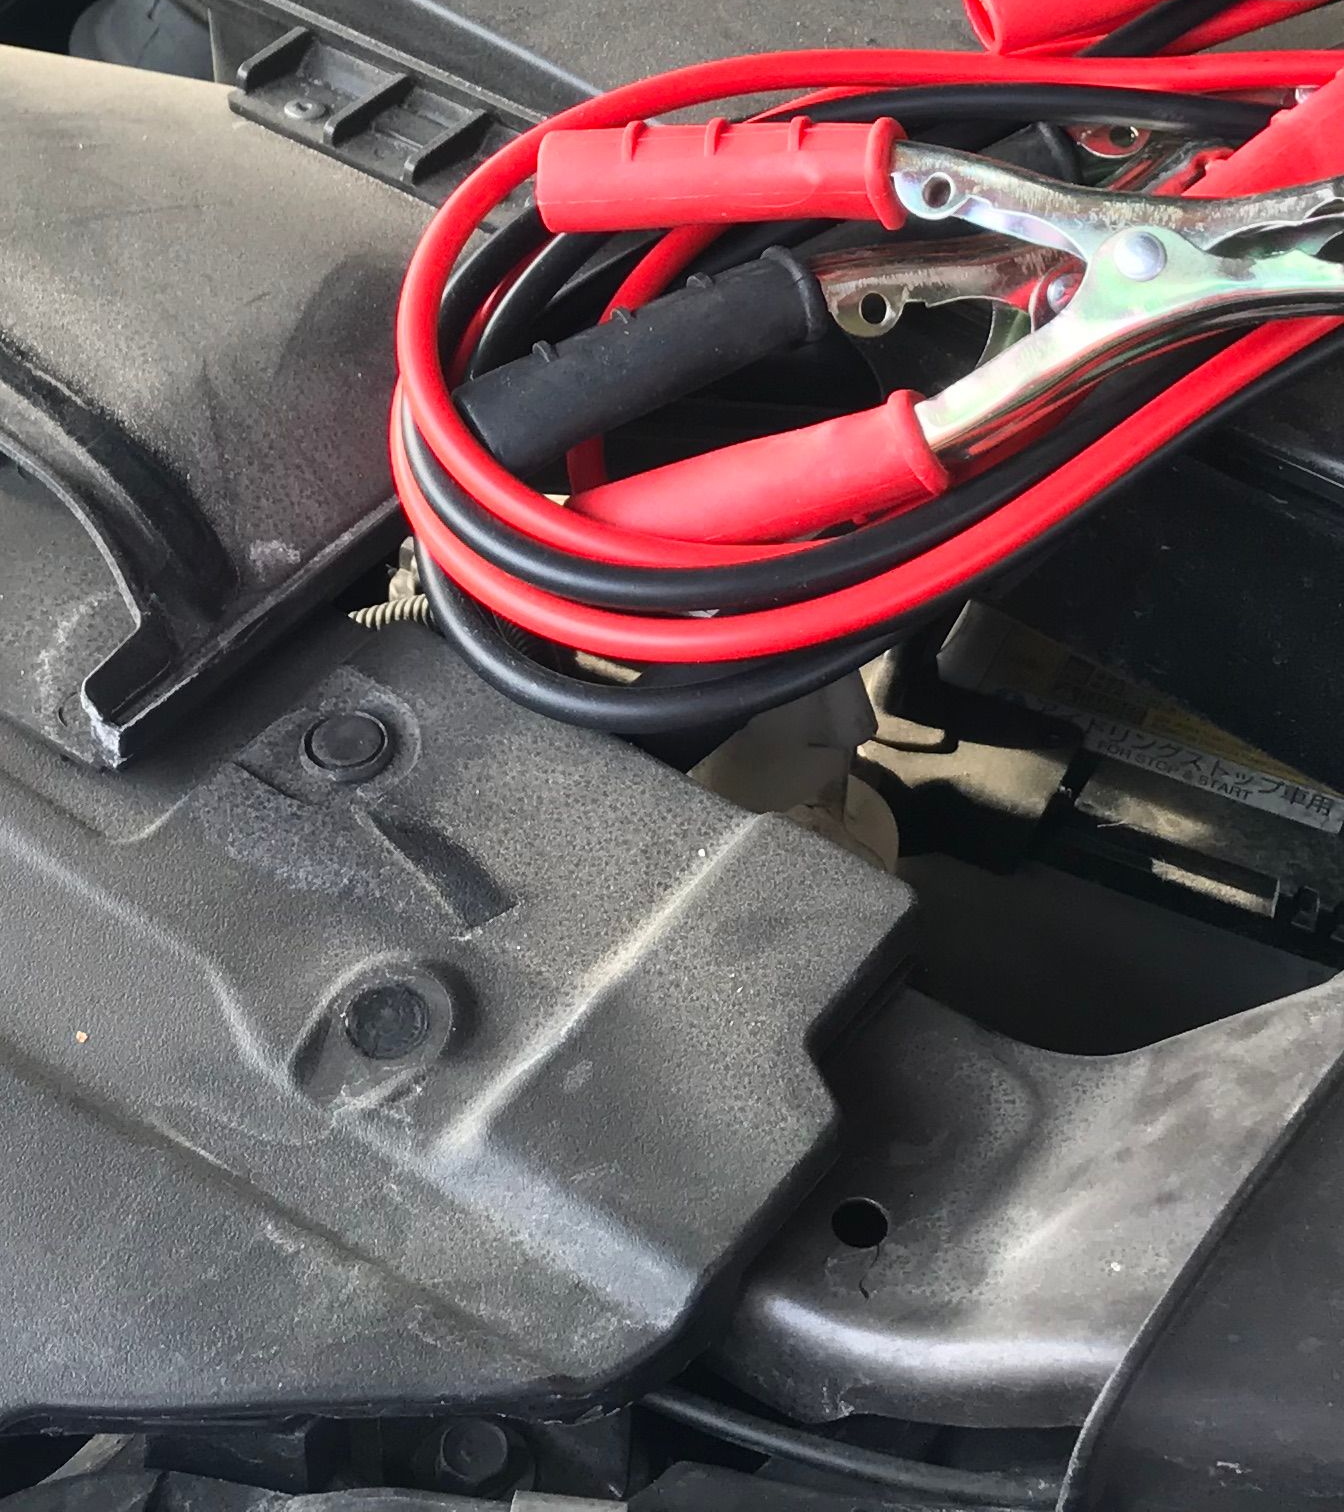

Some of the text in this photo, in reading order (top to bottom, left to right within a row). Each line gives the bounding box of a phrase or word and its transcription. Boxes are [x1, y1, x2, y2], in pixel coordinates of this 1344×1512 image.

[1098, 740, 1132, 760] FOR
[1135, 752, 1179, 776] STOP
[1198, 772, 1253, 801] START
